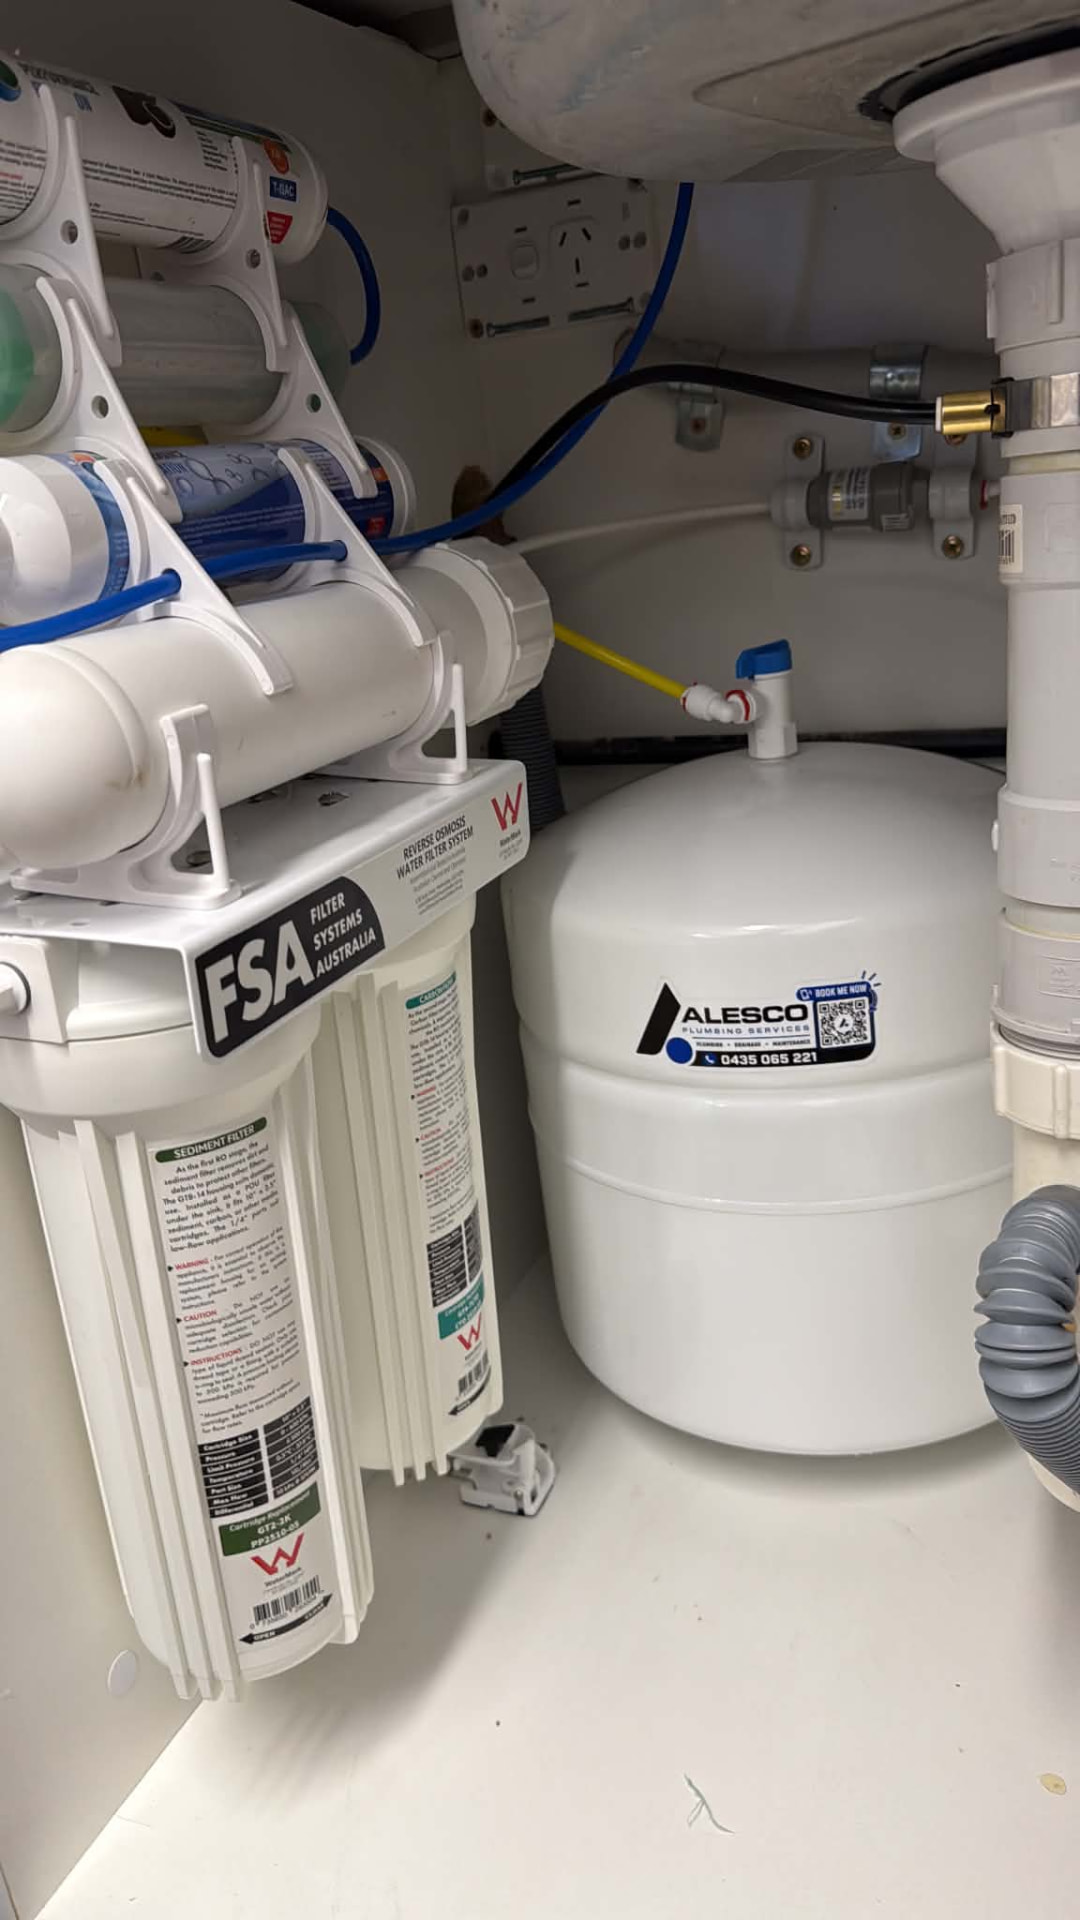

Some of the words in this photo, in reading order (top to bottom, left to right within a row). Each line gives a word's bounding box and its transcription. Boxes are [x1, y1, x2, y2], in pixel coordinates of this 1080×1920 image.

[404, 832, 434, 862] REVERSE
[436, 815, 466, 842] OSMOSIS
[396, 854, 424, 880] WATER
[424, 841, 447, 864] FILTER
[448, 825, 474, 850] SYSTEM
[310, 892, 345, 925] FILTER
[313, 908, 362, 951] SYSTEMS
[316, 927, 376, 979] AUSTRALIA
[205, 920, 316, 1044] FSA
[815, 987, 836, 998] BOOK
[837, 986, 848, 996] ME
[849, 984, 868, 994] NOW
[682, 1004, 808, 1024] ALESCO
[748, 1024, 810, 1034] SERVICES
[720, 1054, 758, 1065] 0435
[761, 1054, 790, 1064] 065
[792, 1052, 817, 1063] 221
[174, 1138, 225, 1159] SEDIMENT
[227, 1126, 255, 1144] FILTER
[200, 1159, 214, 1167] first
[216, 1154, 227, 1162] RO
[164, 1174, 198, 1186] sediment
[171, 1184, 195, 1194] debris
[206, 1173, 230, 1188] protect
[186, 1196, 218, 1210] Installed
[166, 1215, 188, 1225] under
[192, 1210, 204, 1219] the
[170, 1240, 204, 1252] low-flow
[184, 1310, 217, 1322] CAUTION
[190, 1348, 242, 1366] INSTRUCTIONS
[203, 1440, 238, 1451] Cartridge
[238, 1434, 252, 1442] Size
[205, 1452, 236, 1462] Pressure
[225, 1457, 256, 1469] Pressure
[210, 1468, 254, 1484] Temperature
[227, 1484, 242, 1492] Size
[229, 1516, 266, 1532] Cartridge
[254, 1630, 276, 1640] OPEN
